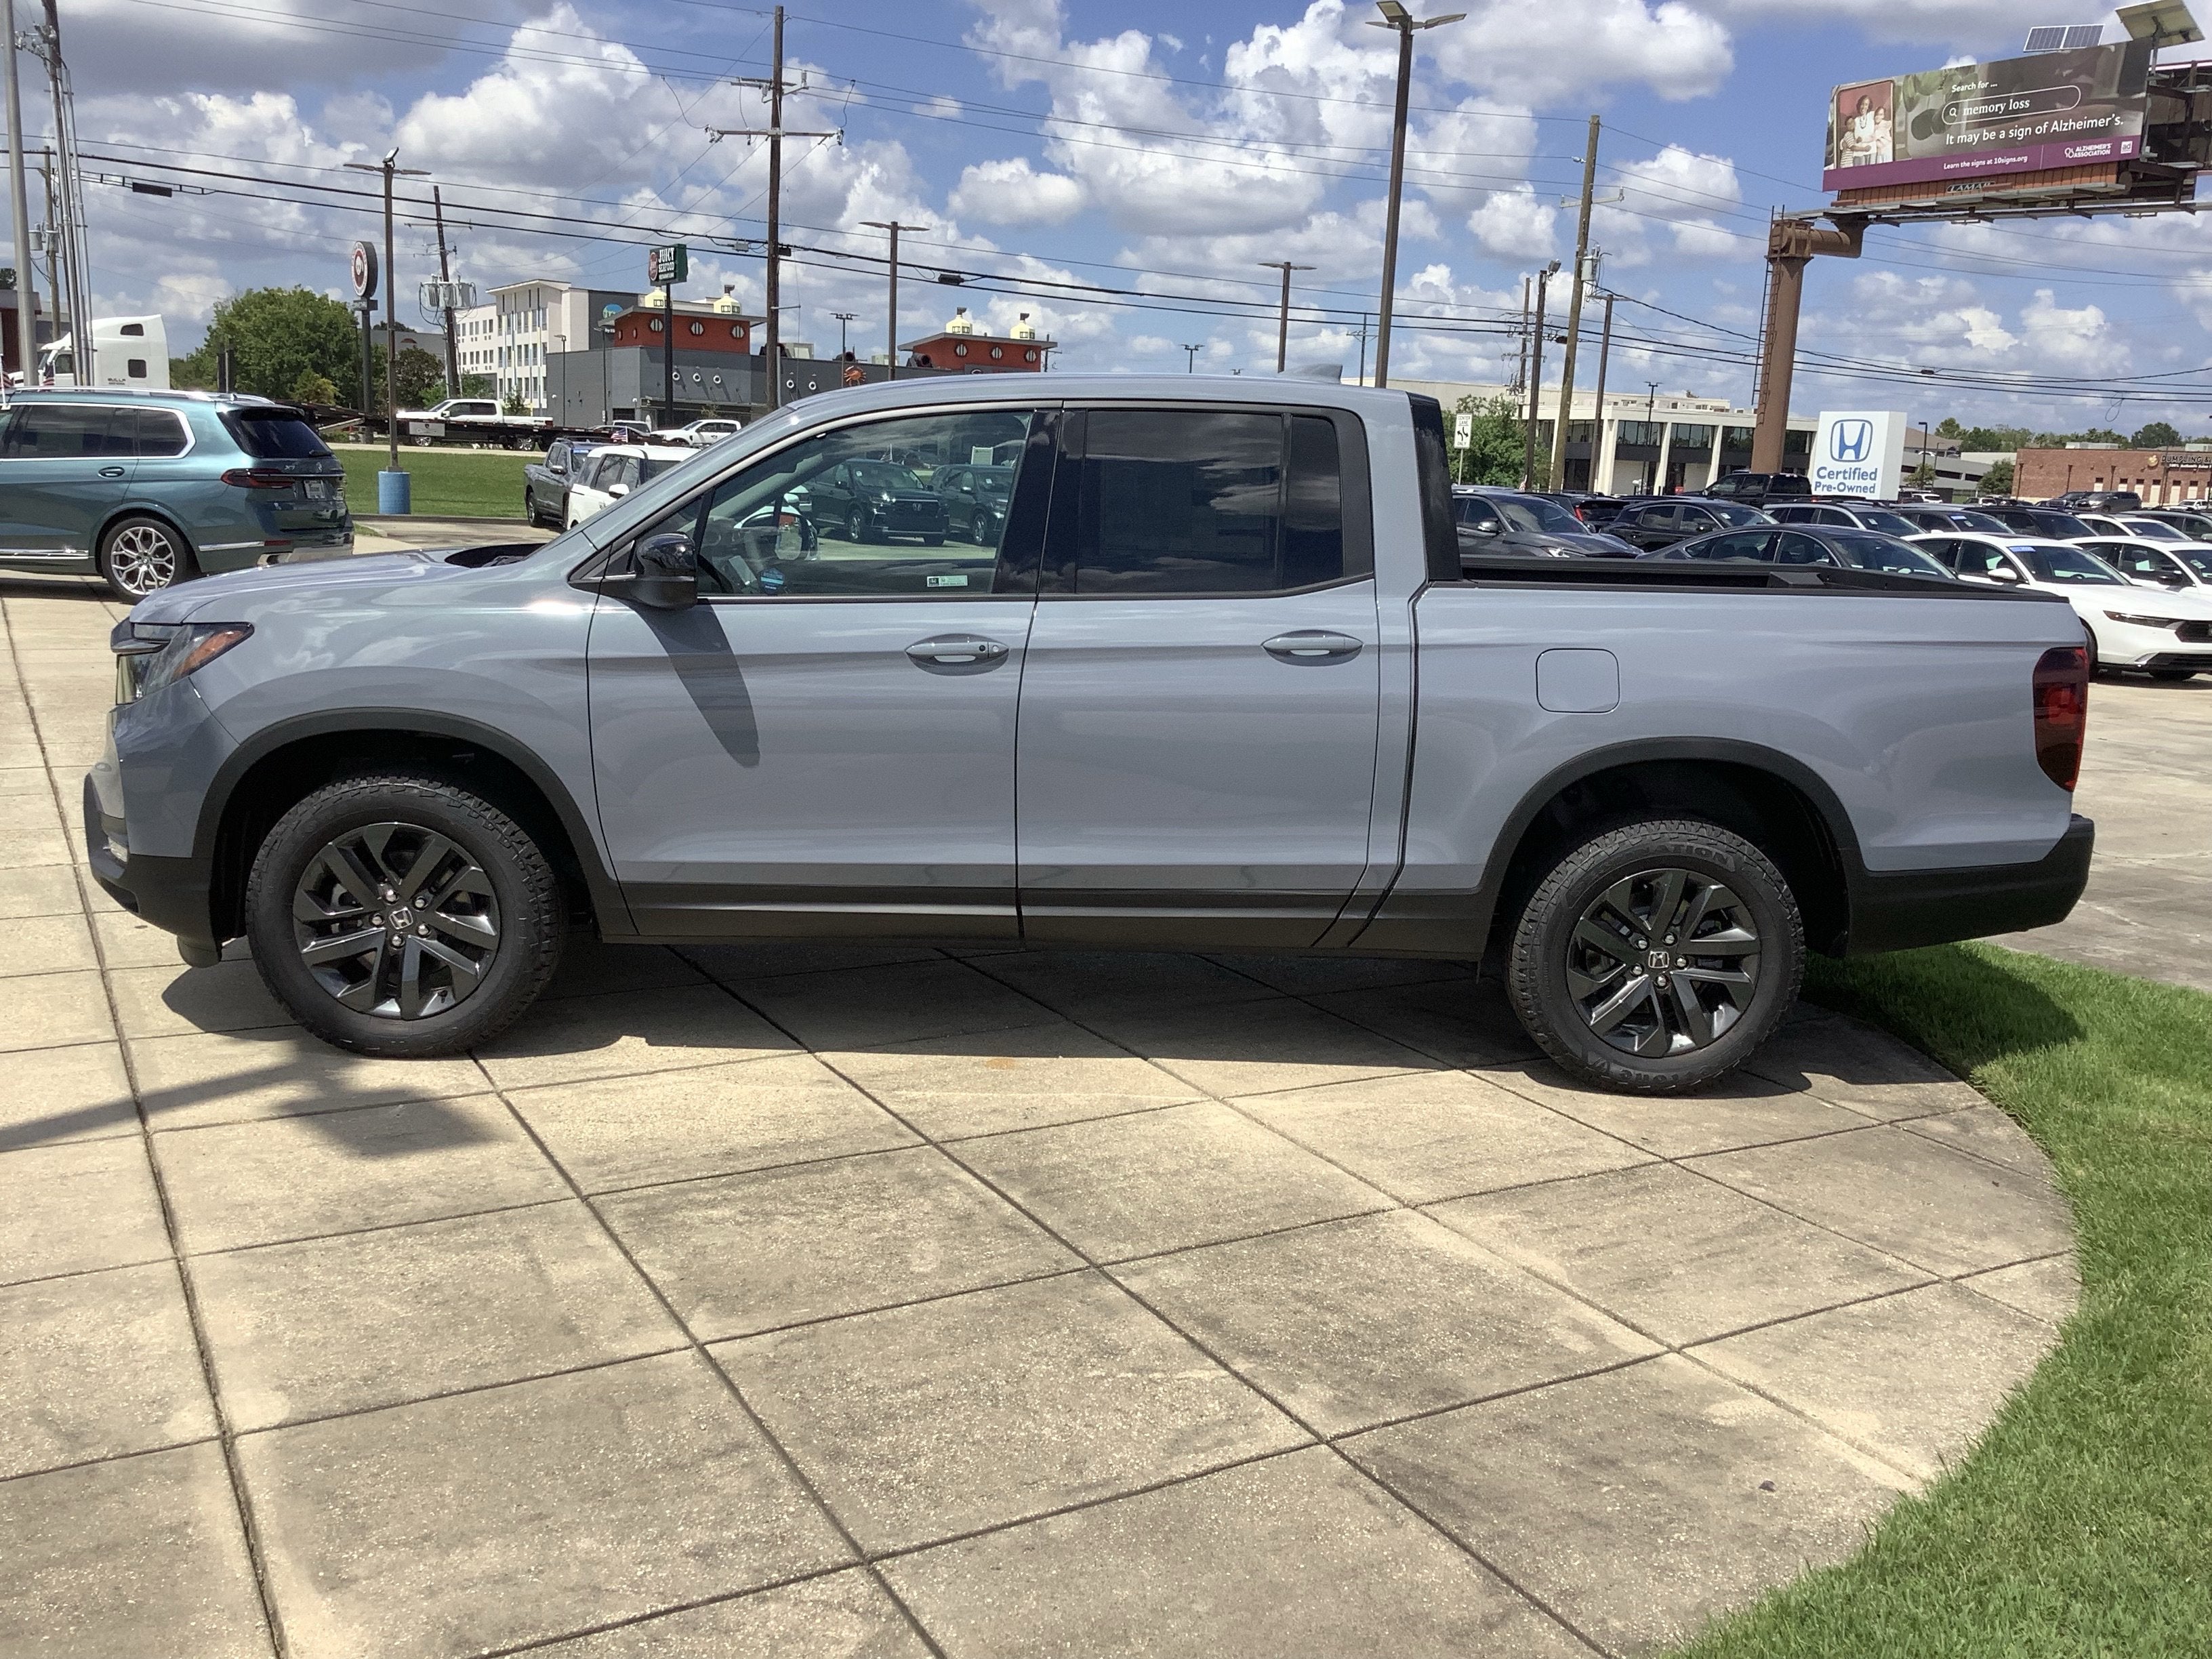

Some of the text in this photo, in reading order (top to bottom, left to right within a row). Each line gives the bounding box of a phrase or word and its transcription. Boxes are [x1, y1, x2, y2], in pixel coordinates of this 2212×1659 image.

[1952, 82, 1976, 93] Search
[1978, 81, 1989, 89] for
[1963, 99, 2030, 116] memory loss
[1946, 134, 1954, 145] It
[1957, 132, 1980, 145] may
[1982, 129, 1995, 141] be
[2009, 125, 2032, 140] sign
[2035, 121, 2049, 134] of
[2050, 114, 2124, 132] Alzheimer's.
[2073, 150, 2110, 158] ASSOCIATION
[1971, 159, 1986, 167] signs
[1994, 156, 2028, 165] 10signs.org
[658, 247, 675, 263] JUICY
[2161, 455, 2202, 464] DUMPLING
[1816, 466, 1878, 480] Certified
[1814, 481, 1876, 493] Pre-Owned
